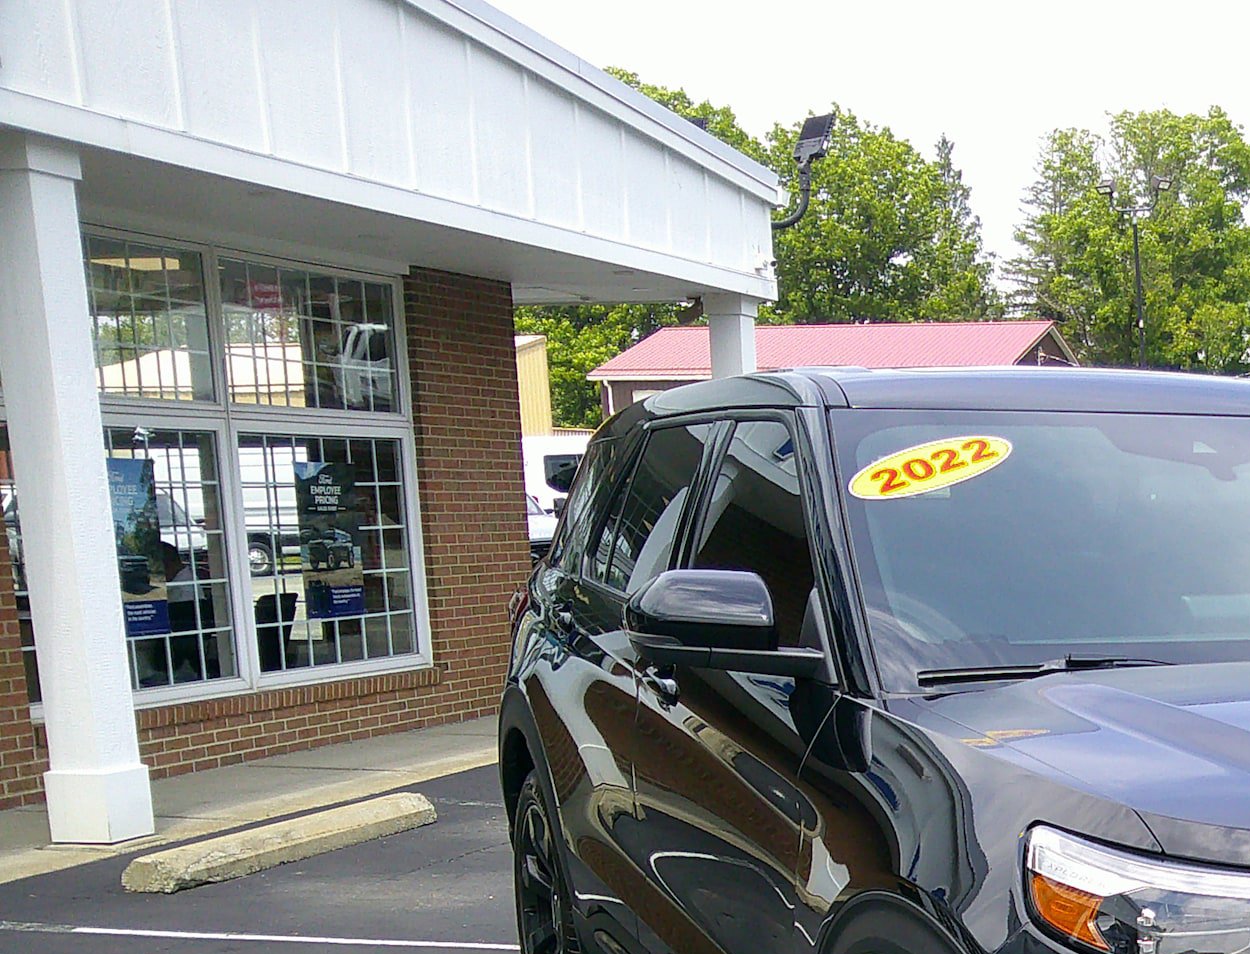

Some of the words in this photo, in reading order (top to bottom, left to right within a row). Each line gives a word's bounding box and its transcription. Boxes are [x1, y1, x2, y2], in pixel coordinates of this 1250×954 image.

[870, 440, 998, 494] 2022
[310, 485, 342, 495] EMPLOYEE
[314, 495, 339, 505] PRICING
